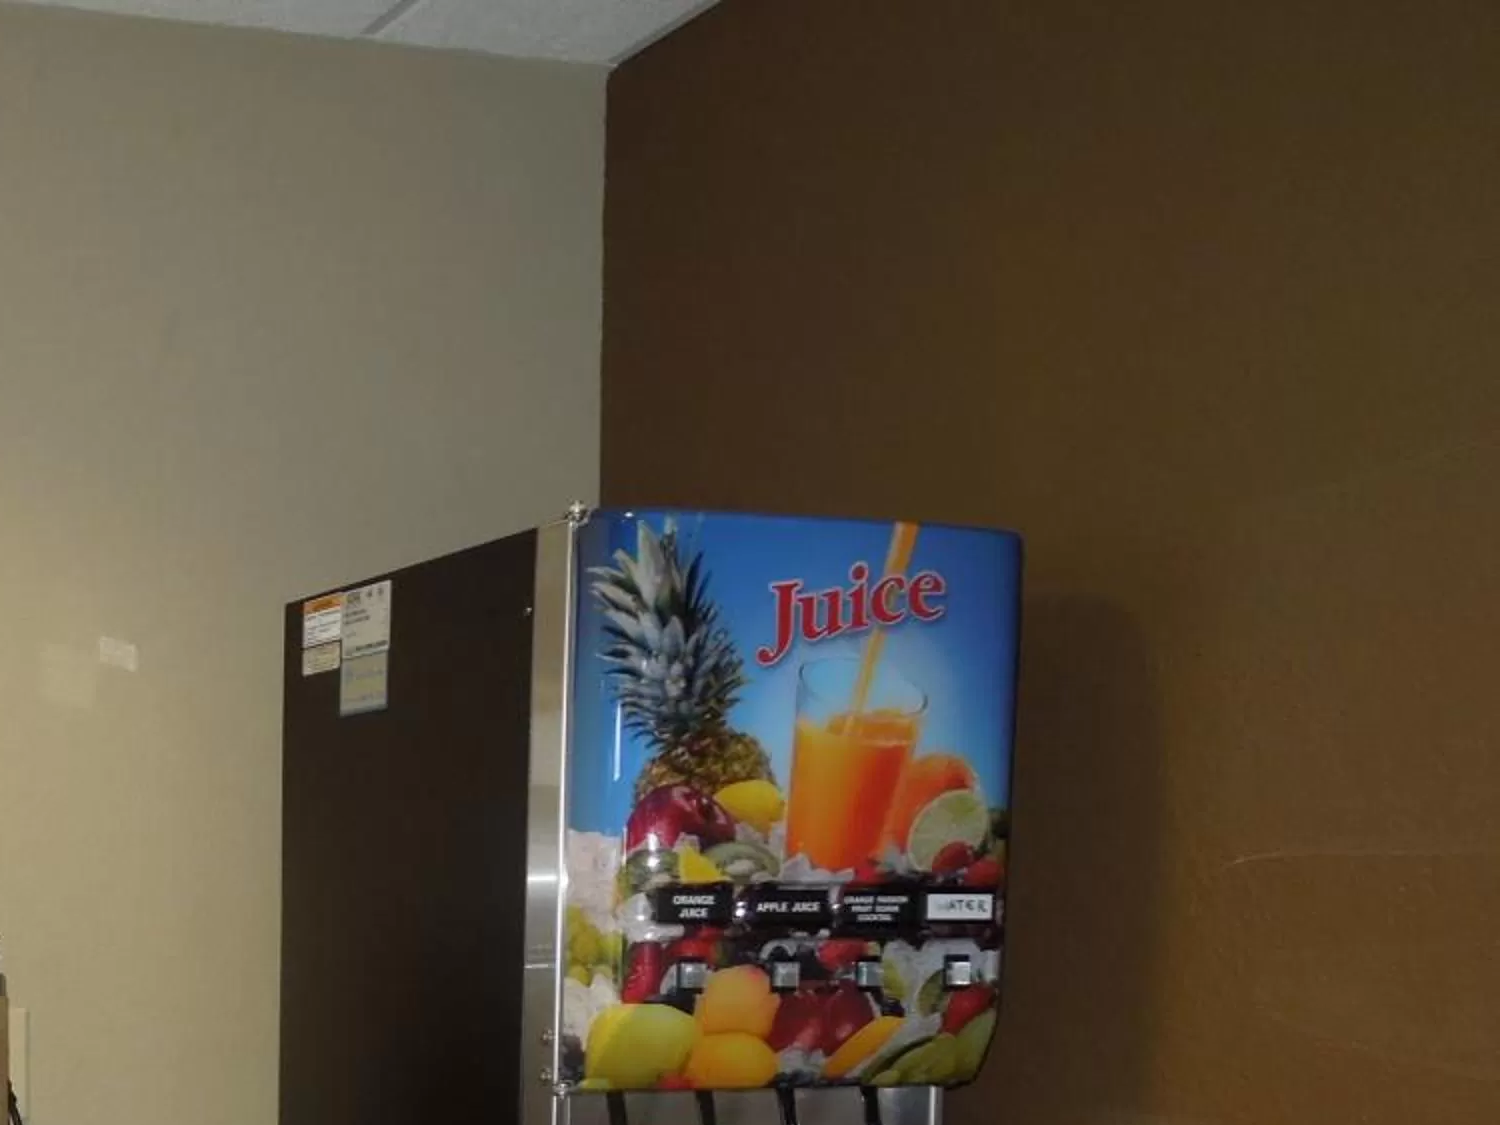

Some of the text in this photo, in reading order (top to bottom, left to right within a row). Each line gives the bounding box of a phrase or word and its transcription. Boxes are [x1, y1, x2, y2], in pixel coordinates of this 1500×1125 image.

[756, 561, 946, 665] Juice
[679, 907, 708, 918] JUICE
[756, 902, 821, 912] APPLE JUICE
